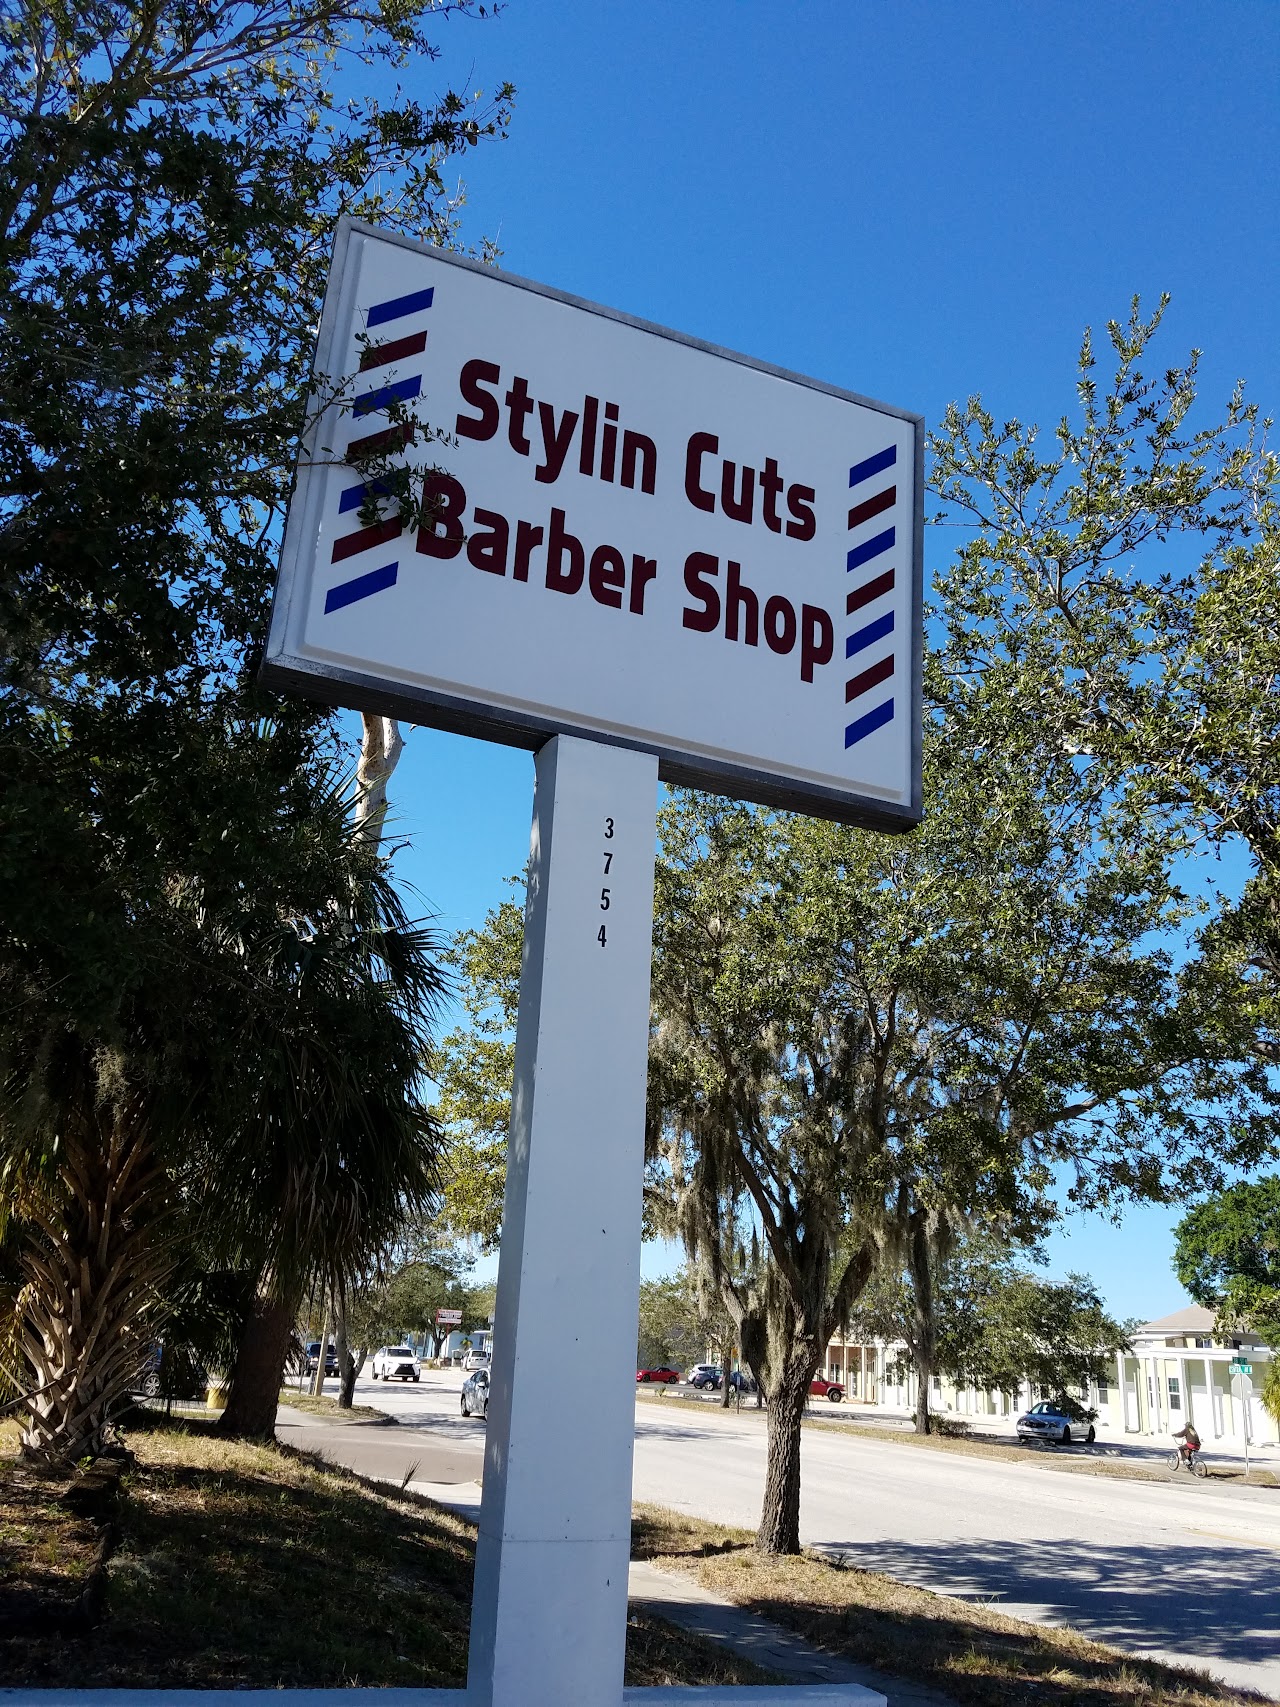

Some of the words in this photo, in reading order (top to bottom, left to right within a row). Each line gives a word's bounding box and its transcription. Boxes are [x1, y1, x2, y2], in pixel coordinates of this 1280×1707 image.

[455, 359, 658, 496] Stylin
[684, 431, 817, 542] Cuts
[415, 471, 658, 616] Barber
[682, 551, 835, 684] Shop
